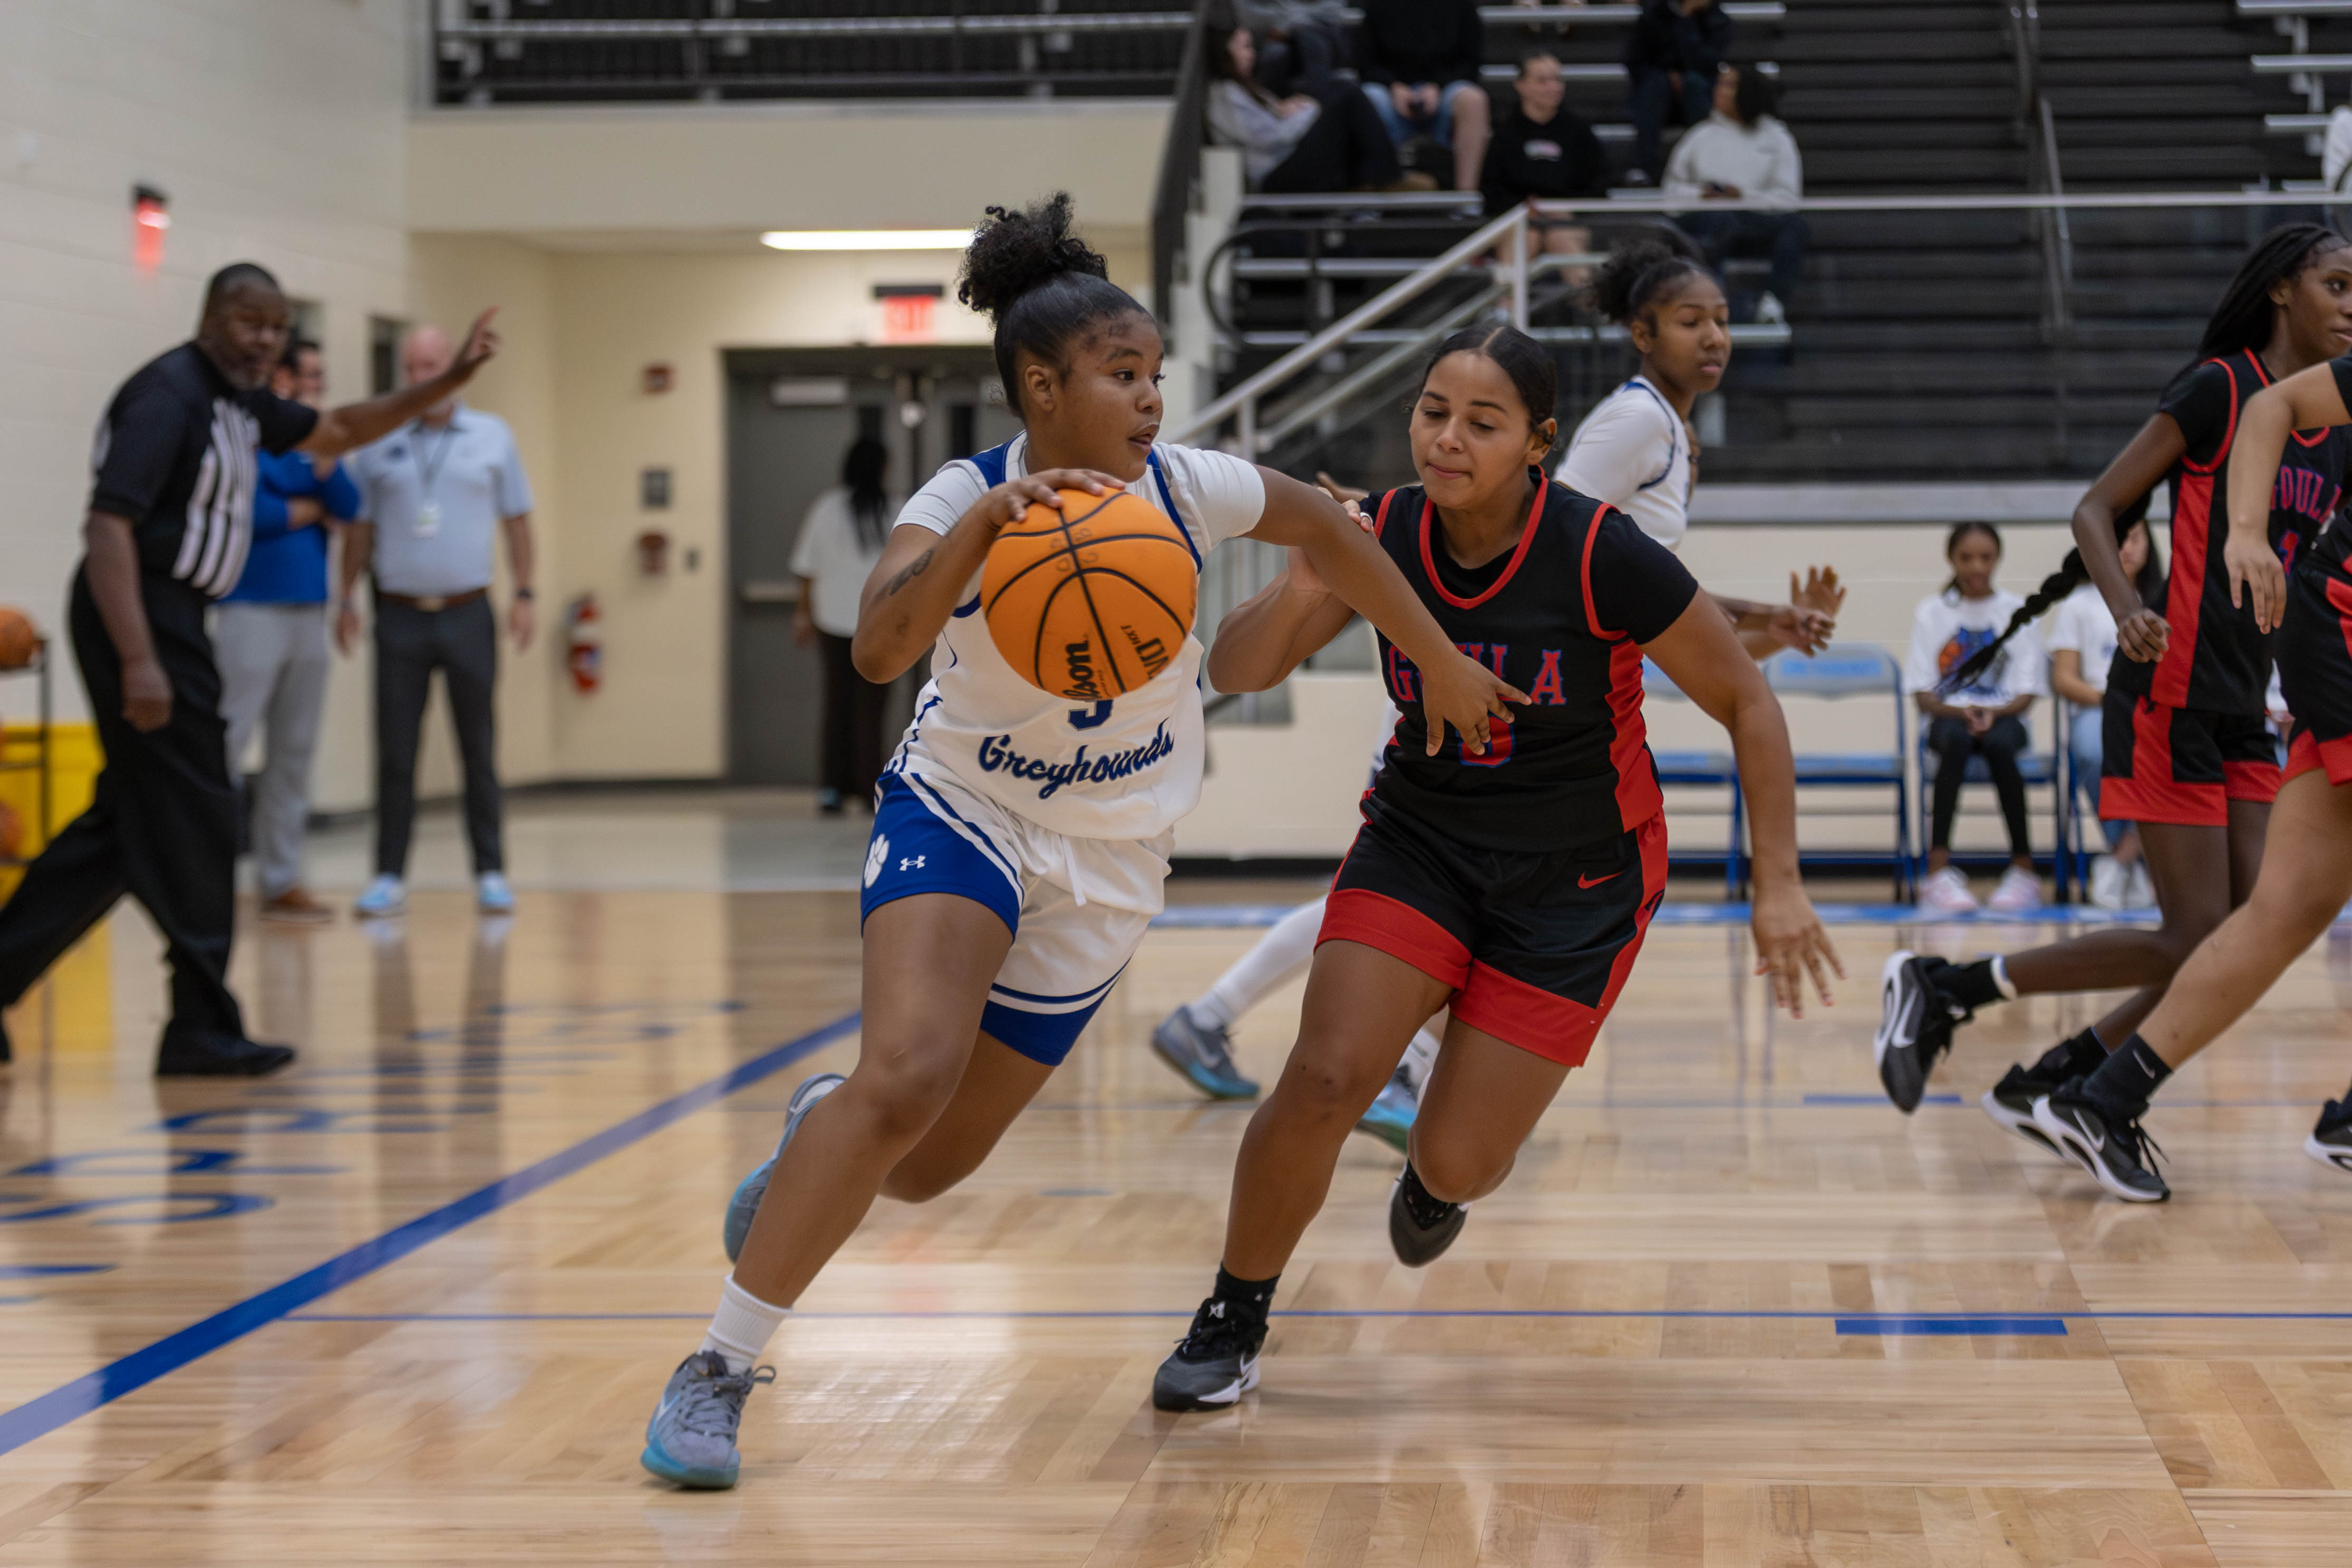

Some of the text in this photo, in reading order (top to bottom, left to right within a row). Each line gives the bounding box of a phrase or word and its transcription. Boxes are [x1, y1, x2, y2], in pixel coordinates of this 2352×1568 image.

[2270, 465, 2342, 525] OUL
[1062, 642, 1102, 699] lson
[1136, 637, 1168, 680] VO
[1388, 642, 1568, 705] GLA
[979, 717, 1175, 800] Greyhounds
